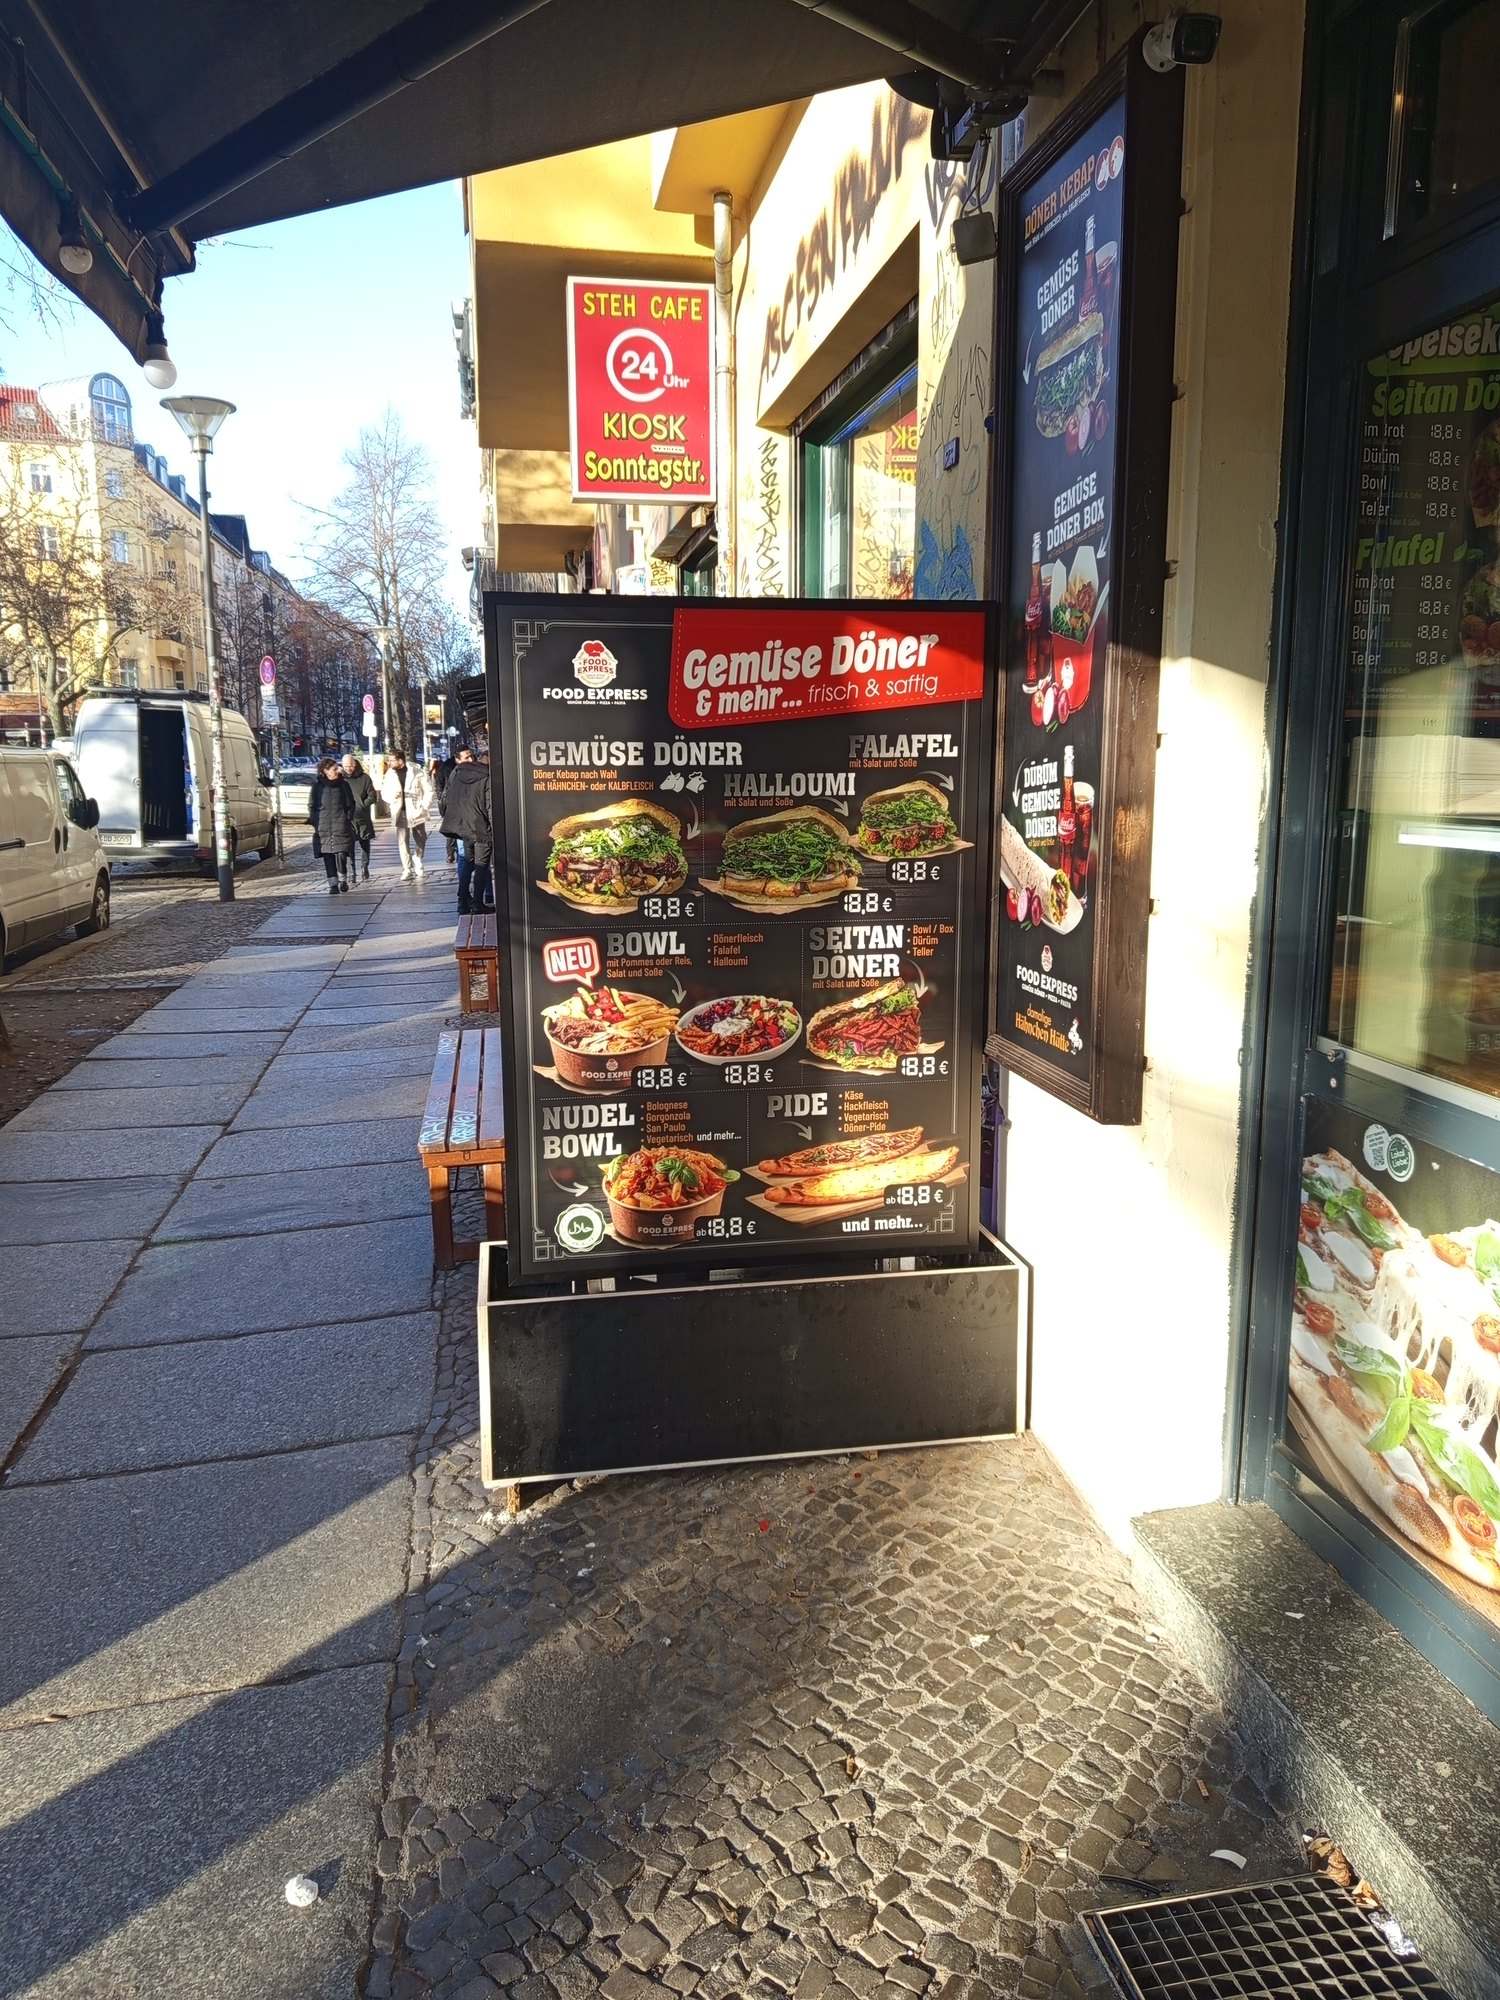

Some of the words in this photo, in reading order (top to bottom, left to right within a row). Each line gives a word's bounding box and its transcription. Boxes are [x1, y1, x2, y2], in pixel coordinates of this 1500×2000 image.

[1025, 191, 1057, 240] DÖNER
[1060, 154, 1095, 208] KEBAP
[1037, 249, 1079, 310] GEMÜSE
[583, 292, 636, 317] STEH
[650, 296, 703, 321] CAFE
[1041, 284, 1075, 335] DÖNER
[621, 350, 658, 380] 24
[663, 373, 690, 388] Uhr
[1372, 380, 1459, 417] Seitan
[603, 412, 687, 441] KIOSK
[1364, 421, 1378, 437] im
[584, 451, 705, 489] Sonntagstr.
[1054, 471, 1097, 519] GEMÜSE
[1047, 512, 1081, 551] DÖNER
[1084, 495, 1105, 529] BOX
[1354, 574, 1369, 589] im
[1353, 599, 1390, 615] Düüm
[577, 665, 614, 674] EXPRESS
[583, 658, 608, 666] FOOD
[683, 640, 823, 690] Gemüse
[830, 630, 939, 677] Döner
[543, 687, 585, 700] FOOD
[587, 688, 648, 700] EXPRESS
[808, 680, 859, 704] frisch
[865, 680, 880, 698] &
[886, 674, 938, 697] saftig
[695, 689, 712, 717] &
[717, 685, 802, 715] mehr...
[530, 735, 644, 766] GEMÜSE
[653, 735, 744, 766] DÖNER
[849, 734, 959, 759] FALAFEL
[849, 759, 861, 768] mit
[863, 758, 882, 768] Salat
[883, 759, 898, 768] und
[899, 758, 918, 768] Soße
[1023, 757, 1058, 788] DÜRÜM
[533, 769, 555, 779] Döner
[556, 770, 579, 781] Kebap
[580, 770, 598, 779] nach
[599, 769, 617, 779] Wahl
[533, 781, 546, 791] mit
[547, 780, 589, 791] HÄHNCHEN-
[590, 781, 606, 791] oder
[608, 781, 654, 791] KALBFLEISCH
[723, 772, 856, 797] HALLOUMI
[724, 798, 736, 807] mit
[737, 797, 758, 807] Salat
[758, 798, 773, 807] und
[774, 797, 793, 807] Soße
[1021, 785, 1061, 814] GEMÜSE
[1025, 813, 1058, 838] DÖNER
[891, 861, 926, 883] 18,8
[930, 865, 941, 881] €
[643, 897, 680, 920] 18,8
[684, 902, 695, 918] €
[843, 893, 878, 915] 18,8
[882, 897, 892, 913] €
[713, 933, 764, 944] Dönerfleisch
[809, 925, 904, 951] SEITAN
[912, 924, 932, 934] Bowl
[939, 924, 954, 934] Box
[606, 931, 685, 957] BOWL
[713, 945, 741, 956] Falafel
[912, 935, 938, 945] Dürüm
[550, 945, 593, 974] NEU
[606, 958, 619, 968] mit
[620, 958, 655, 968] Pommes
[655, 957, 673, 967] oder
[713, 957, 748, 967] Halloumi
[912, 947, 934, 957] Teller
[606, 969, 626, 978] Salat
[627, 969, 643, 978] und
[643, 968, 663, 977] Soße
[812, 949, 900, 980] DÖNER
[812, 980, 825, 989] mit
[826, 979, 845, 989] Salat
[846, 979, 861, 988] und
[861, 978, 880, 988] Soße
[1016, 964, 1040, 986] FOOD
[1040, 973, 1078, 1001] EXPRESS
[1015, 1011, 1049, 1043] Hähnchen
[581, 1071, 605, 1079] FOOD
[724, 1064, 760, 1086] 18,8
[763, 1069, 774, 1083] €
[901, 1056, 936, 1077] 18,8
[939, 1061, 949, 1075] €
[637, 1068, 673, 1090] 18,8
[677, 1072, 688, 1086] €
[767, 1092, 828, 1118] PIDE
[844, 1090, 864, 1100] Käse
[844, 1100, 889, 1111] Hackfleisch
[542, 1102, 635, 1130] NUDEL
[646, 1101, 688, 1112] Bolognese
[844, 1111, 889, 1122] Vegetarisch
[646, 1112, 691, 1123] Gorgonzola
[646, 1124, 662, 1133] San
[663, 1123, 686, 1132] Paulo
[843, 1122, 887, 1133] Döner-Pide
[543, 1132, 622, 1159] BOWL
[646, 1133, 693, 1144] Vegetarisch
[696, 1132, 712, 1141] und
[714, 1131, 741, 1141] mehr...
[886, 1196, 896, 1204] ab
[896, 1185, 931, 1206] 18,8
[934, 1189, 944, 1203] €
[569, 1221, 593, 1235] حلال
[638, 1226, 661, 1234] FOOD
[696, 1229, 707, 1237] ab
[707, 1217, 743, 1238] 18,8
[746, 1220, 757, 1235] €
[842, 1217, 869, 1233] und
[874, 1216, 923, 1230] mehr...
